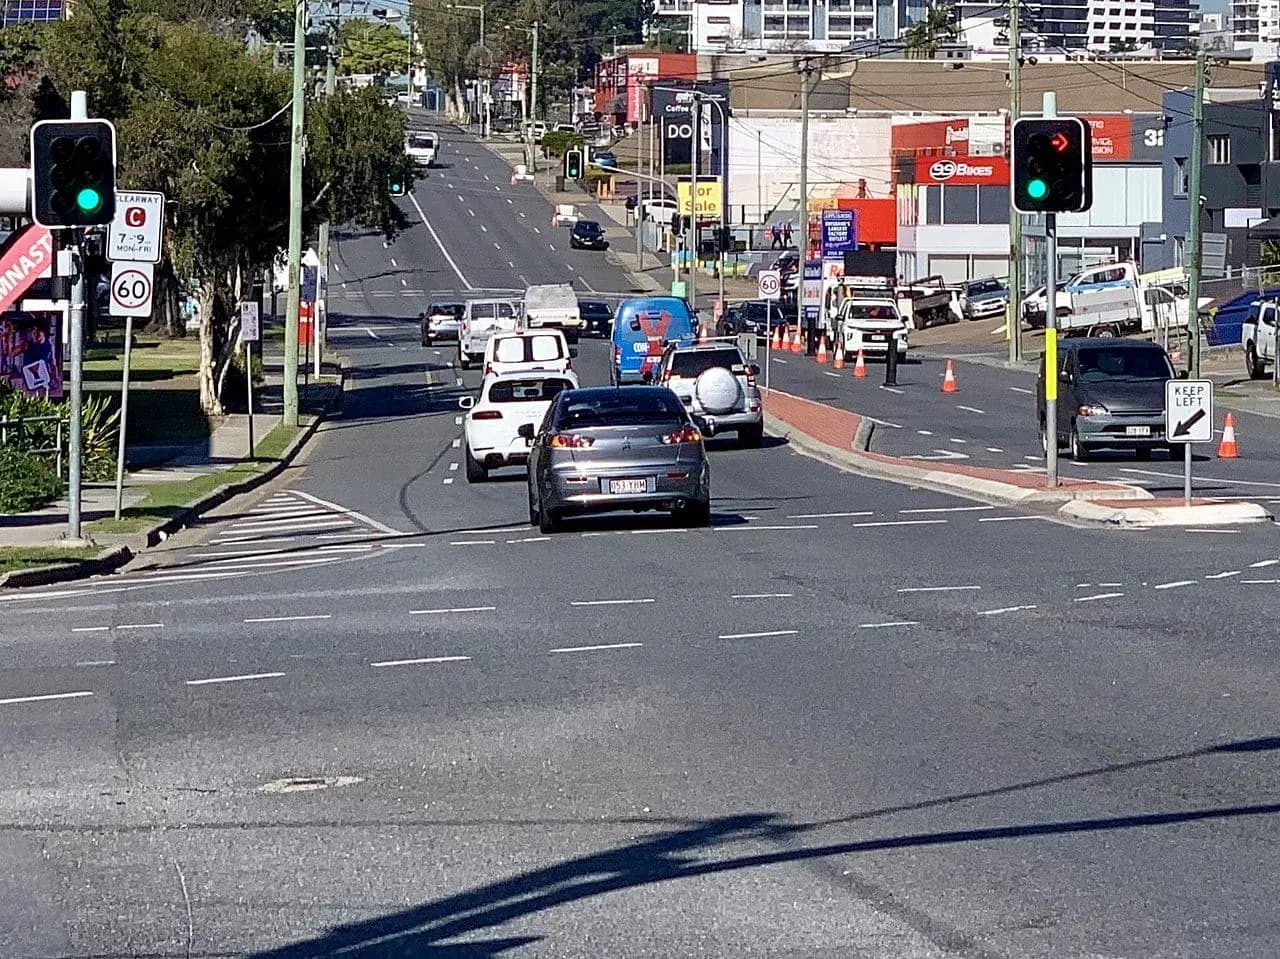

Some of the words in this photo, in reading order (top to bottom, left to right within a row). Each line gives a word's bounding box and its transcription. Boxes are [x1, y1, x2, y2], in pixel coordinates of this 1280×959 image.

[932, 163, 954, 177] 99
[956, 163, 993, 177] BIKES
[116, 196, 159, 204] LEARWAY
[685, 200, 717, 212] Sale
[118, 280, 145, 299] 60
[762, 280, 777, 290] 60
[1174, 386, 1205, 396] KEEP
[1175, 396, 1203, 407] LEFT
